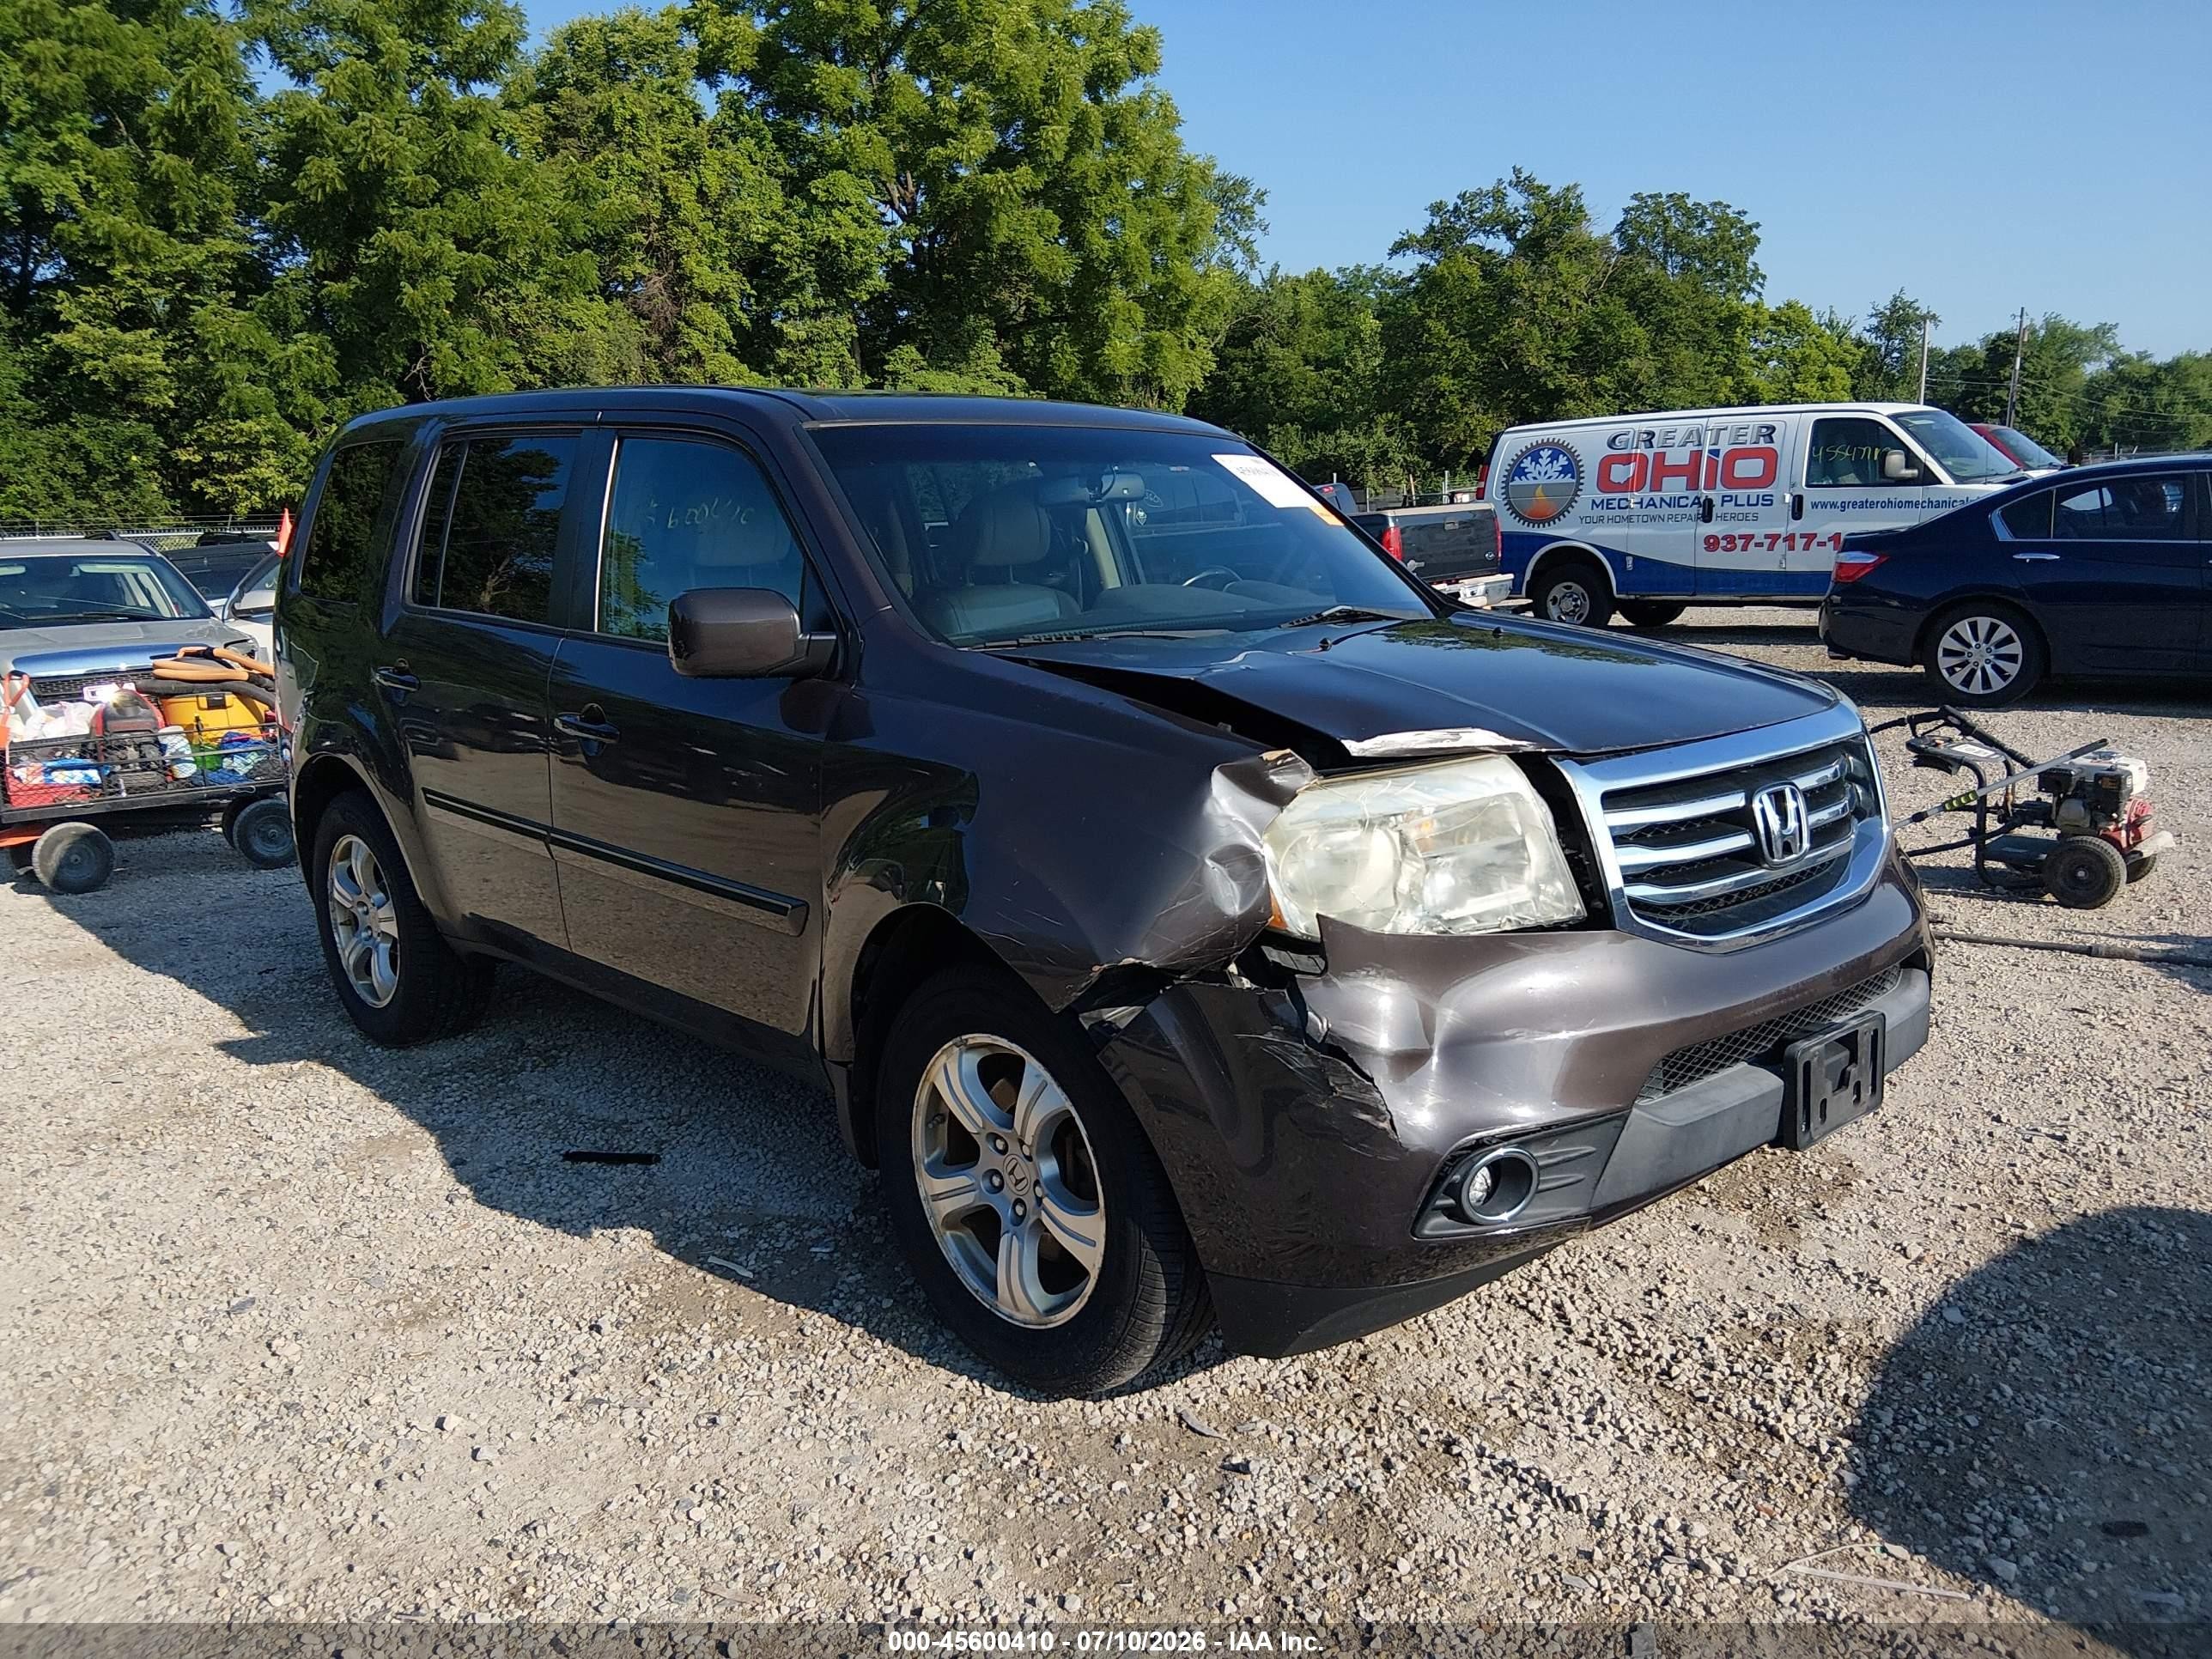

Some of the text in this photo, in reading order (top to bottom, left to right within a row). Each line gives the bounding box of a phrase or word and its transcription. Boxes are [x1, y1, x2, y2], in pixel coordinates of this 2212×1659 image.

[1607, 423, 1777, 450] GREATER
[1721, 494, 1774, 507] PLUS
[1579, 515, 1605, 525] YOUR
[1607, 514, 1665, 524] HOMETOWN
[1715, 512, 1759, 522] HEROES
